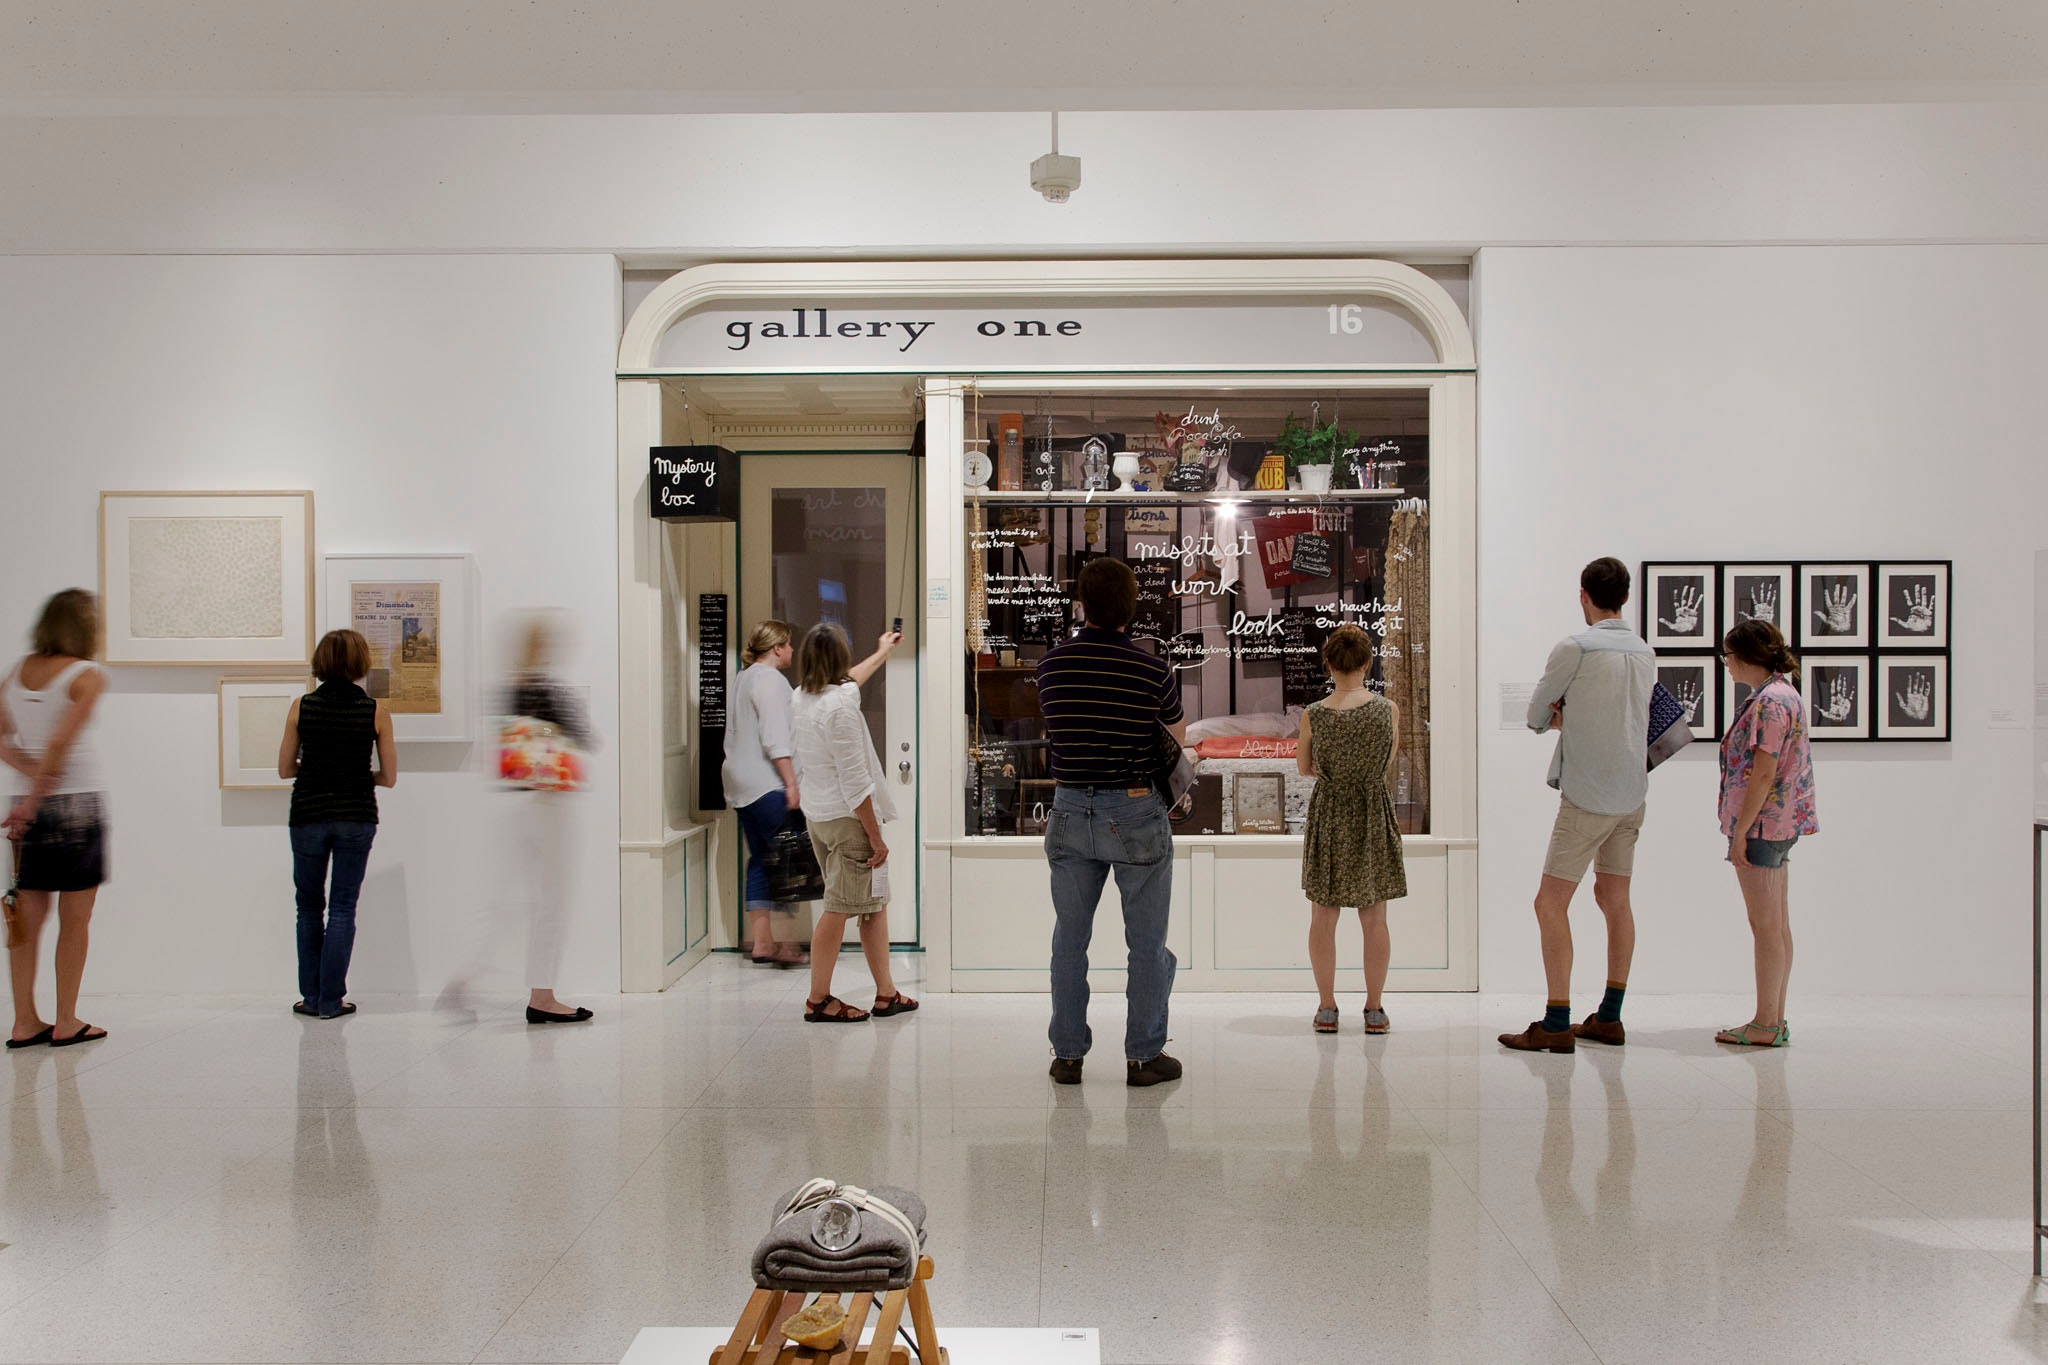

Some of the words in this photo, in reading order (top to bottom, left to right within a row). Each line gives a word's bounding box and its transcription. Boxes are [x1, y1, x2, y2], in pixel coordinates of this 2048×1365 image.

[1328, 303, 1362, 336] 16
[727, 307, 936, 352] gallery
[977, 319, 1083, 337] one
[654, 456, 717, 487] Mystery
[1036, 464, 1056, 476] art
[1254, 468, 1283, 490] KUB
[660, 486, 695, 506] box
[992, 538, 1016, 548] home
[1134, 532, 1219, 567] misfits
[1222, 530, 1256, 557] at
[1134, 564, 1154, 574] art
[983, 573, 994, 582] the
[995, 572, 1019, 581] human
[1019, 573, 1052, 584] sculpture
[1144, 577, 1166, 586] dead
[1171, 569, 1239, 596] work
[985, 586, 1010, 595] needs
[1011, 584, 1036, 595] sleep
[1136, 590, 1164, 604] story
[987, 596, 1010, 606] wake
[1024, 598, 1037, 607] up
[1315, 602, 1337, 613] we
[1339, 599, 1370, 613] have
[1371, 597, 1403, 614] had
[1132, 621, 1162, 631] doubt
[1226, 607, 1285, 637] look
[1315, 614, 1369, 631] enh
[1371, 616, 1388, 637] of
[1389, 615, 1405, 630] it
[1169, 643, 1194, 660] stop
[1195, 644, 1232, 658] looking
[1232, 647, 1252, 660] you
[1252, 646, 1267, 654] are
[1267, 644, 1283, 655] too
[1282, 646, 1318, 654] curious
